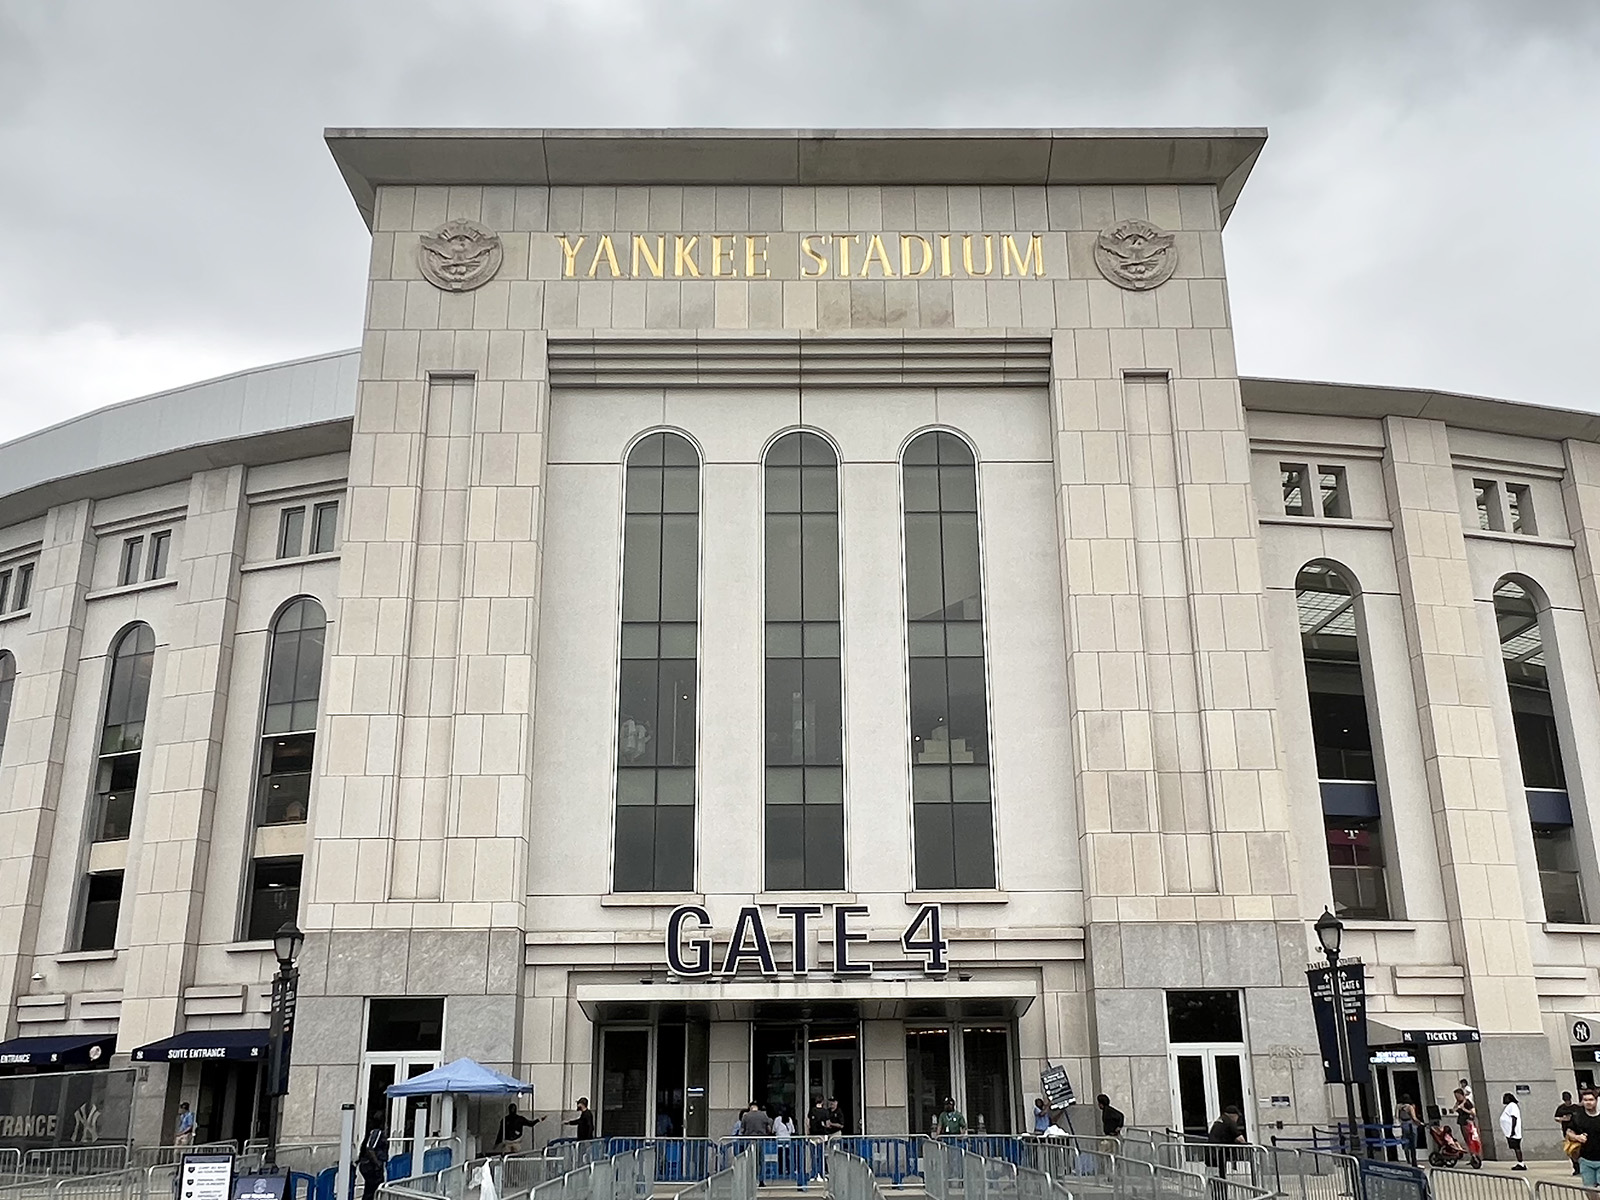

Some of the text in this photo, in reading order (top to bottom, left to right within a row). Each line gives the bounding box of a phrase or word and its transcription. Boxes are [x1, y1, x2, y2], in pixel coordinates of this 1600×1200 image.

[554, 234, 1047, 277] YANKEE STADIUM
[665, 903, 949, 976] GATE 4
[1425, 1032, 1458, 1041] TICKETS
[0, 1053, 31, 1063] ENTRANCE
[168, 1049, 188, 1059] SUITE
[189, 1048, 226, 1059] ENTRANCE
[1269, 1045, 1303, 1058] PRESS
[1269, 1057, 1304, 1070] GATE
[71, 1103, 100, 1142] NY
